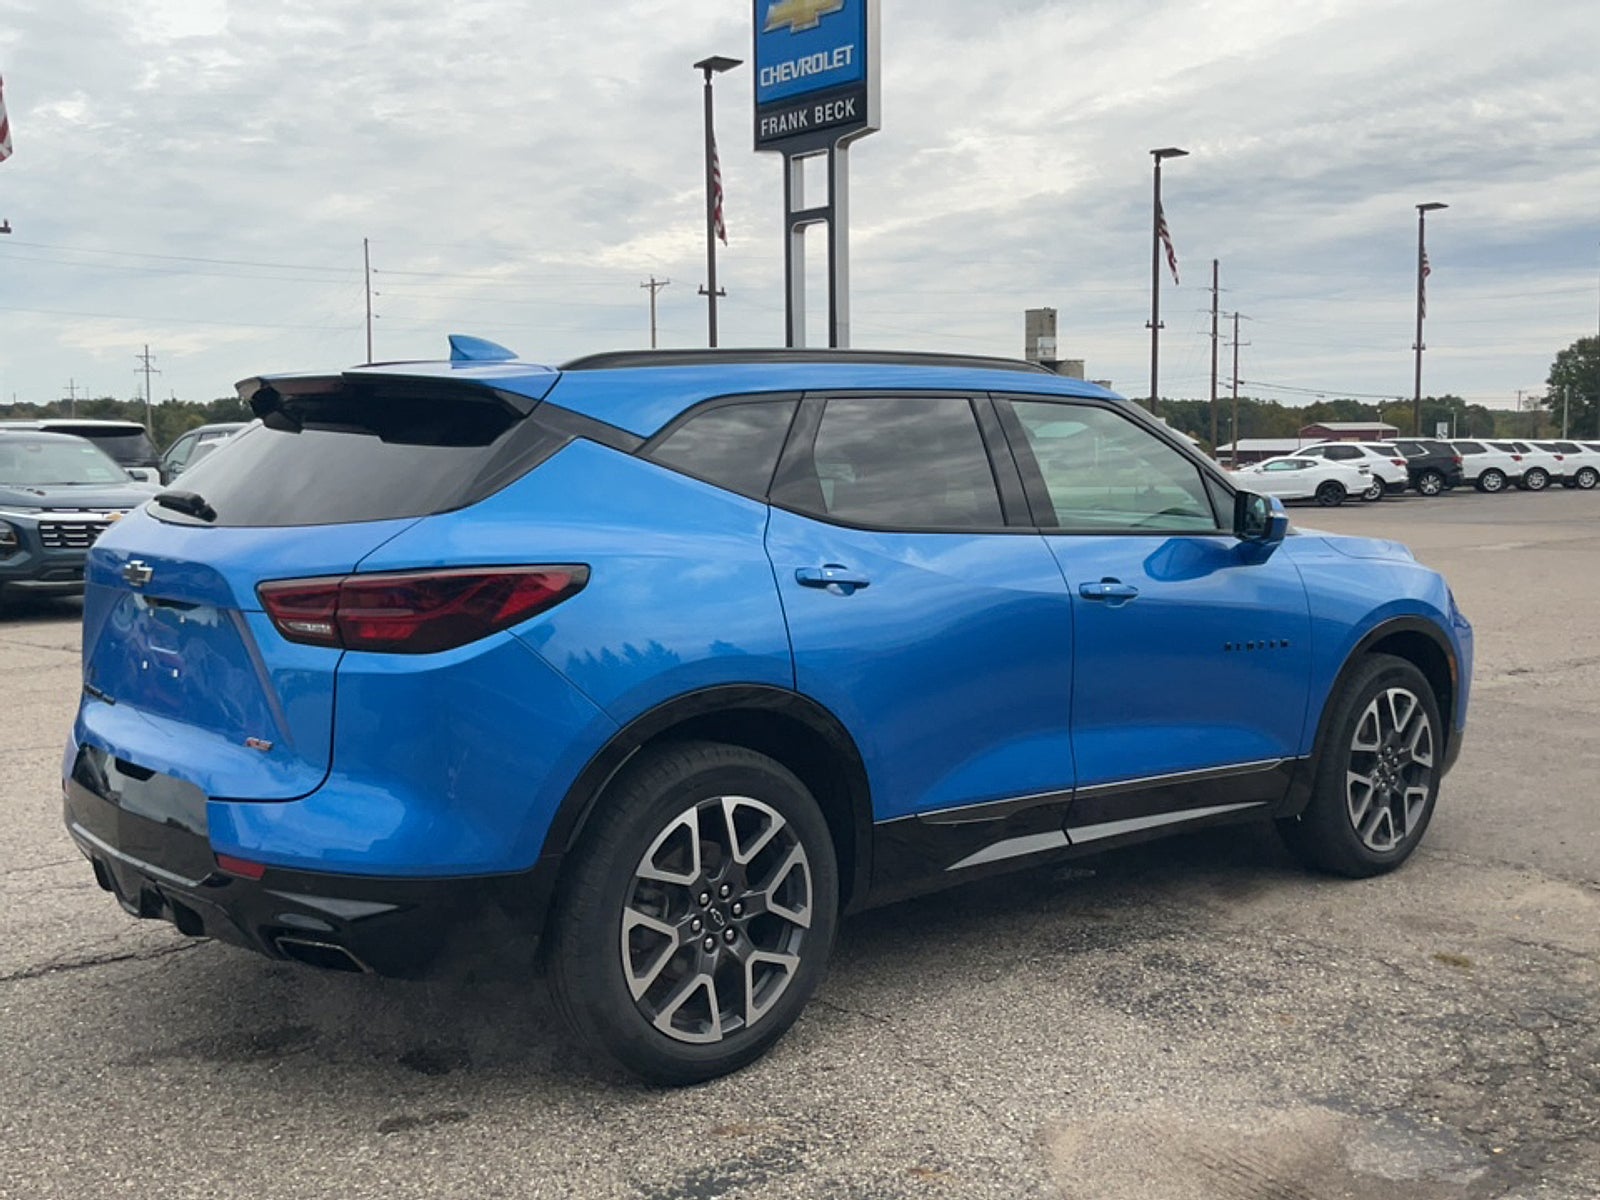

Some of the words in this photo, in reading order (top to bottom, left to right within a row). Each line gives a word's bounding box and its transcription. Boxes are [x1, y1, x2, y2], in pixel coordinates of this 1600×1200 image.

[760, 44, 854, 87] CHEVROLET
[761, 109, 808, 136] FRANK
[814, 97, 855, 124] BECK
